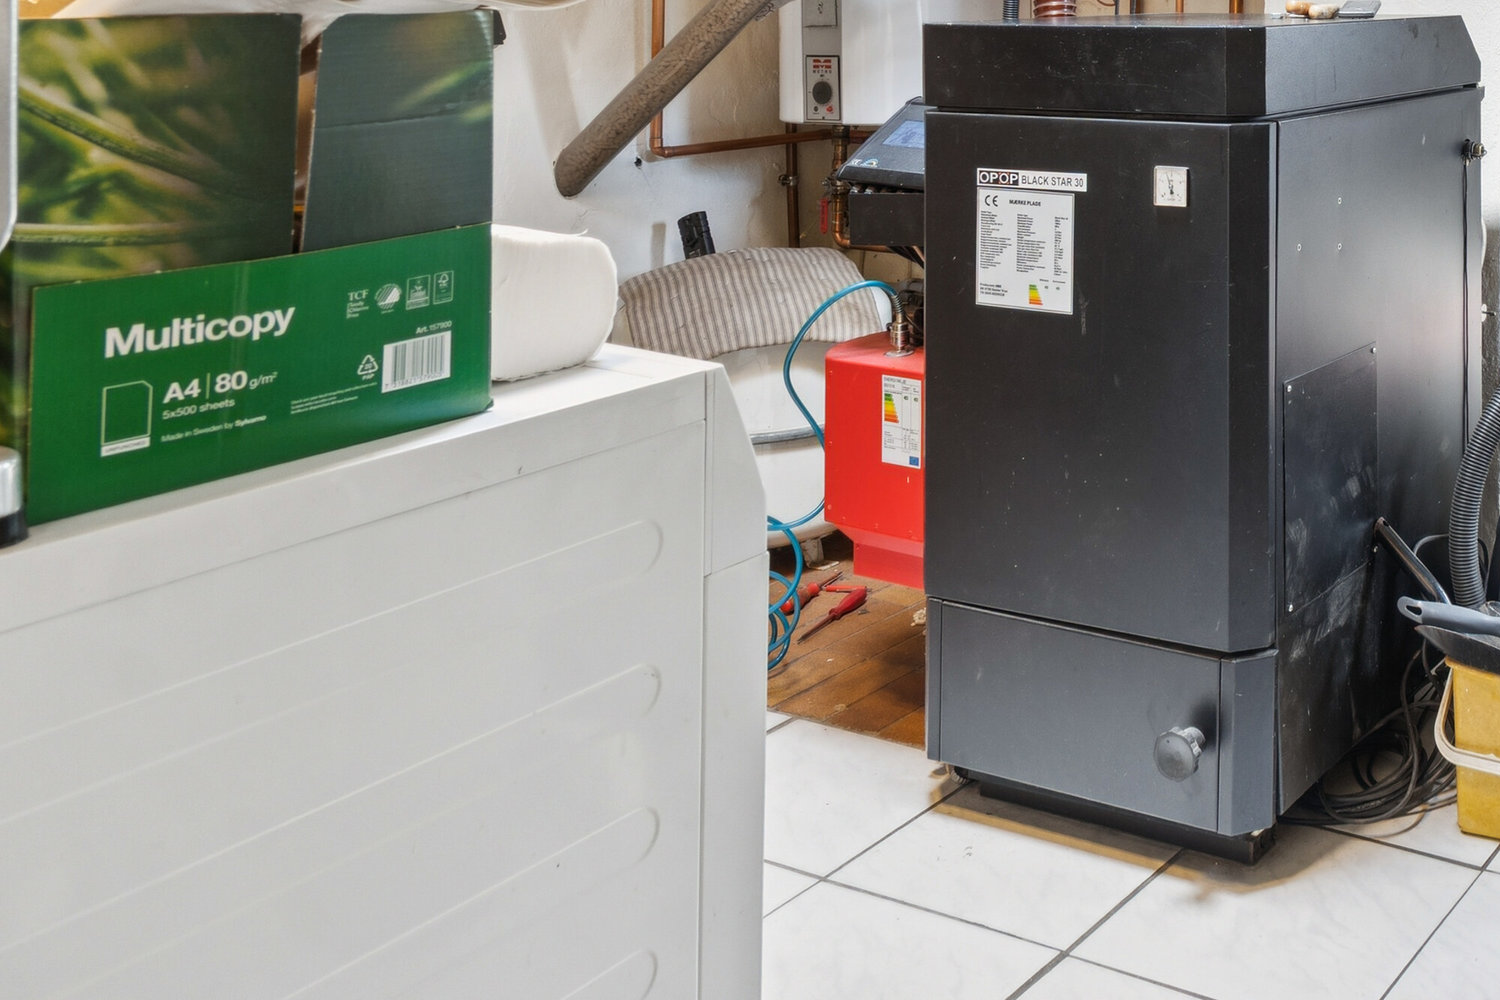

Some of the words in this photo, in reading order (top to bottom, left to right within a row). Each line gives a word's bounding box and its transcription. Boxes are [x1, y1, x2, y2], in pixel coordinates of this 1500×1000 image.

[980, 171, 1018, 186] OPOP
[1022, 175, 1049, 186] BLACK
[1051, 176, 1073, 187] STAR
[1075, 178, 1084, 188] 30
[348, 289, 369, 301] TCF
[105, 307, 296, 358] Multicopy
[163, 378, 201, 403] A4
[215, 371, 248, 393] 80
[162, 405, 197, 420] 5x500
[199, 399, 235, 413] sheets
[161, 432, 184, 442] Made
[193, 423, 223, 436] Sweden
[224, 421, 233, 430] by
